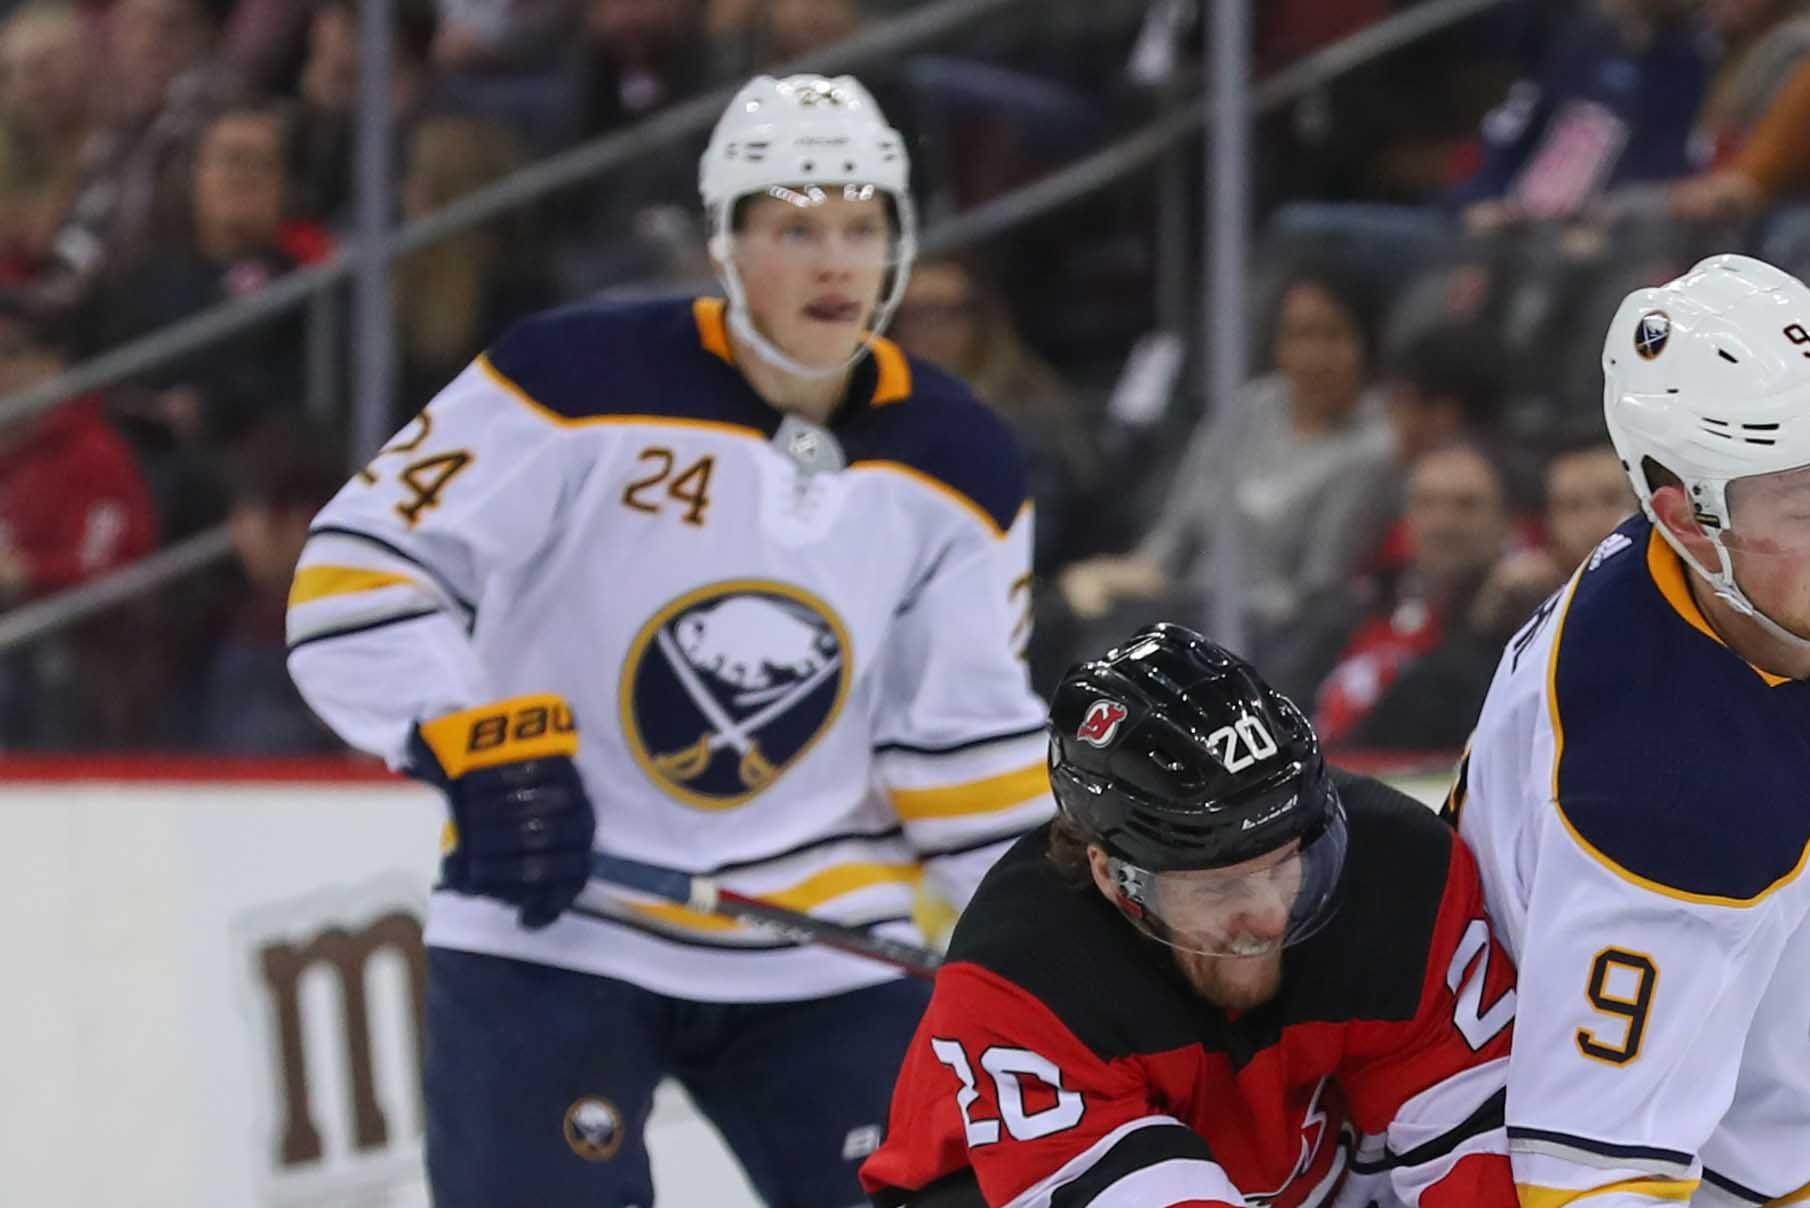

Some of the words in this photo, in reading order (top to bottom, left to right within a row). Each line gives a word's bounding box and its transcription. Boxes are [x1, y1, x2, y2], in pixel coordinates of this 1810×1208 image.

[621, 445, 716, 526] 24
[1206, 715, 1278, 774] 20
[1574, 944, 1662, 1068] 9
[931, 1034, 1087, 1149] 20
